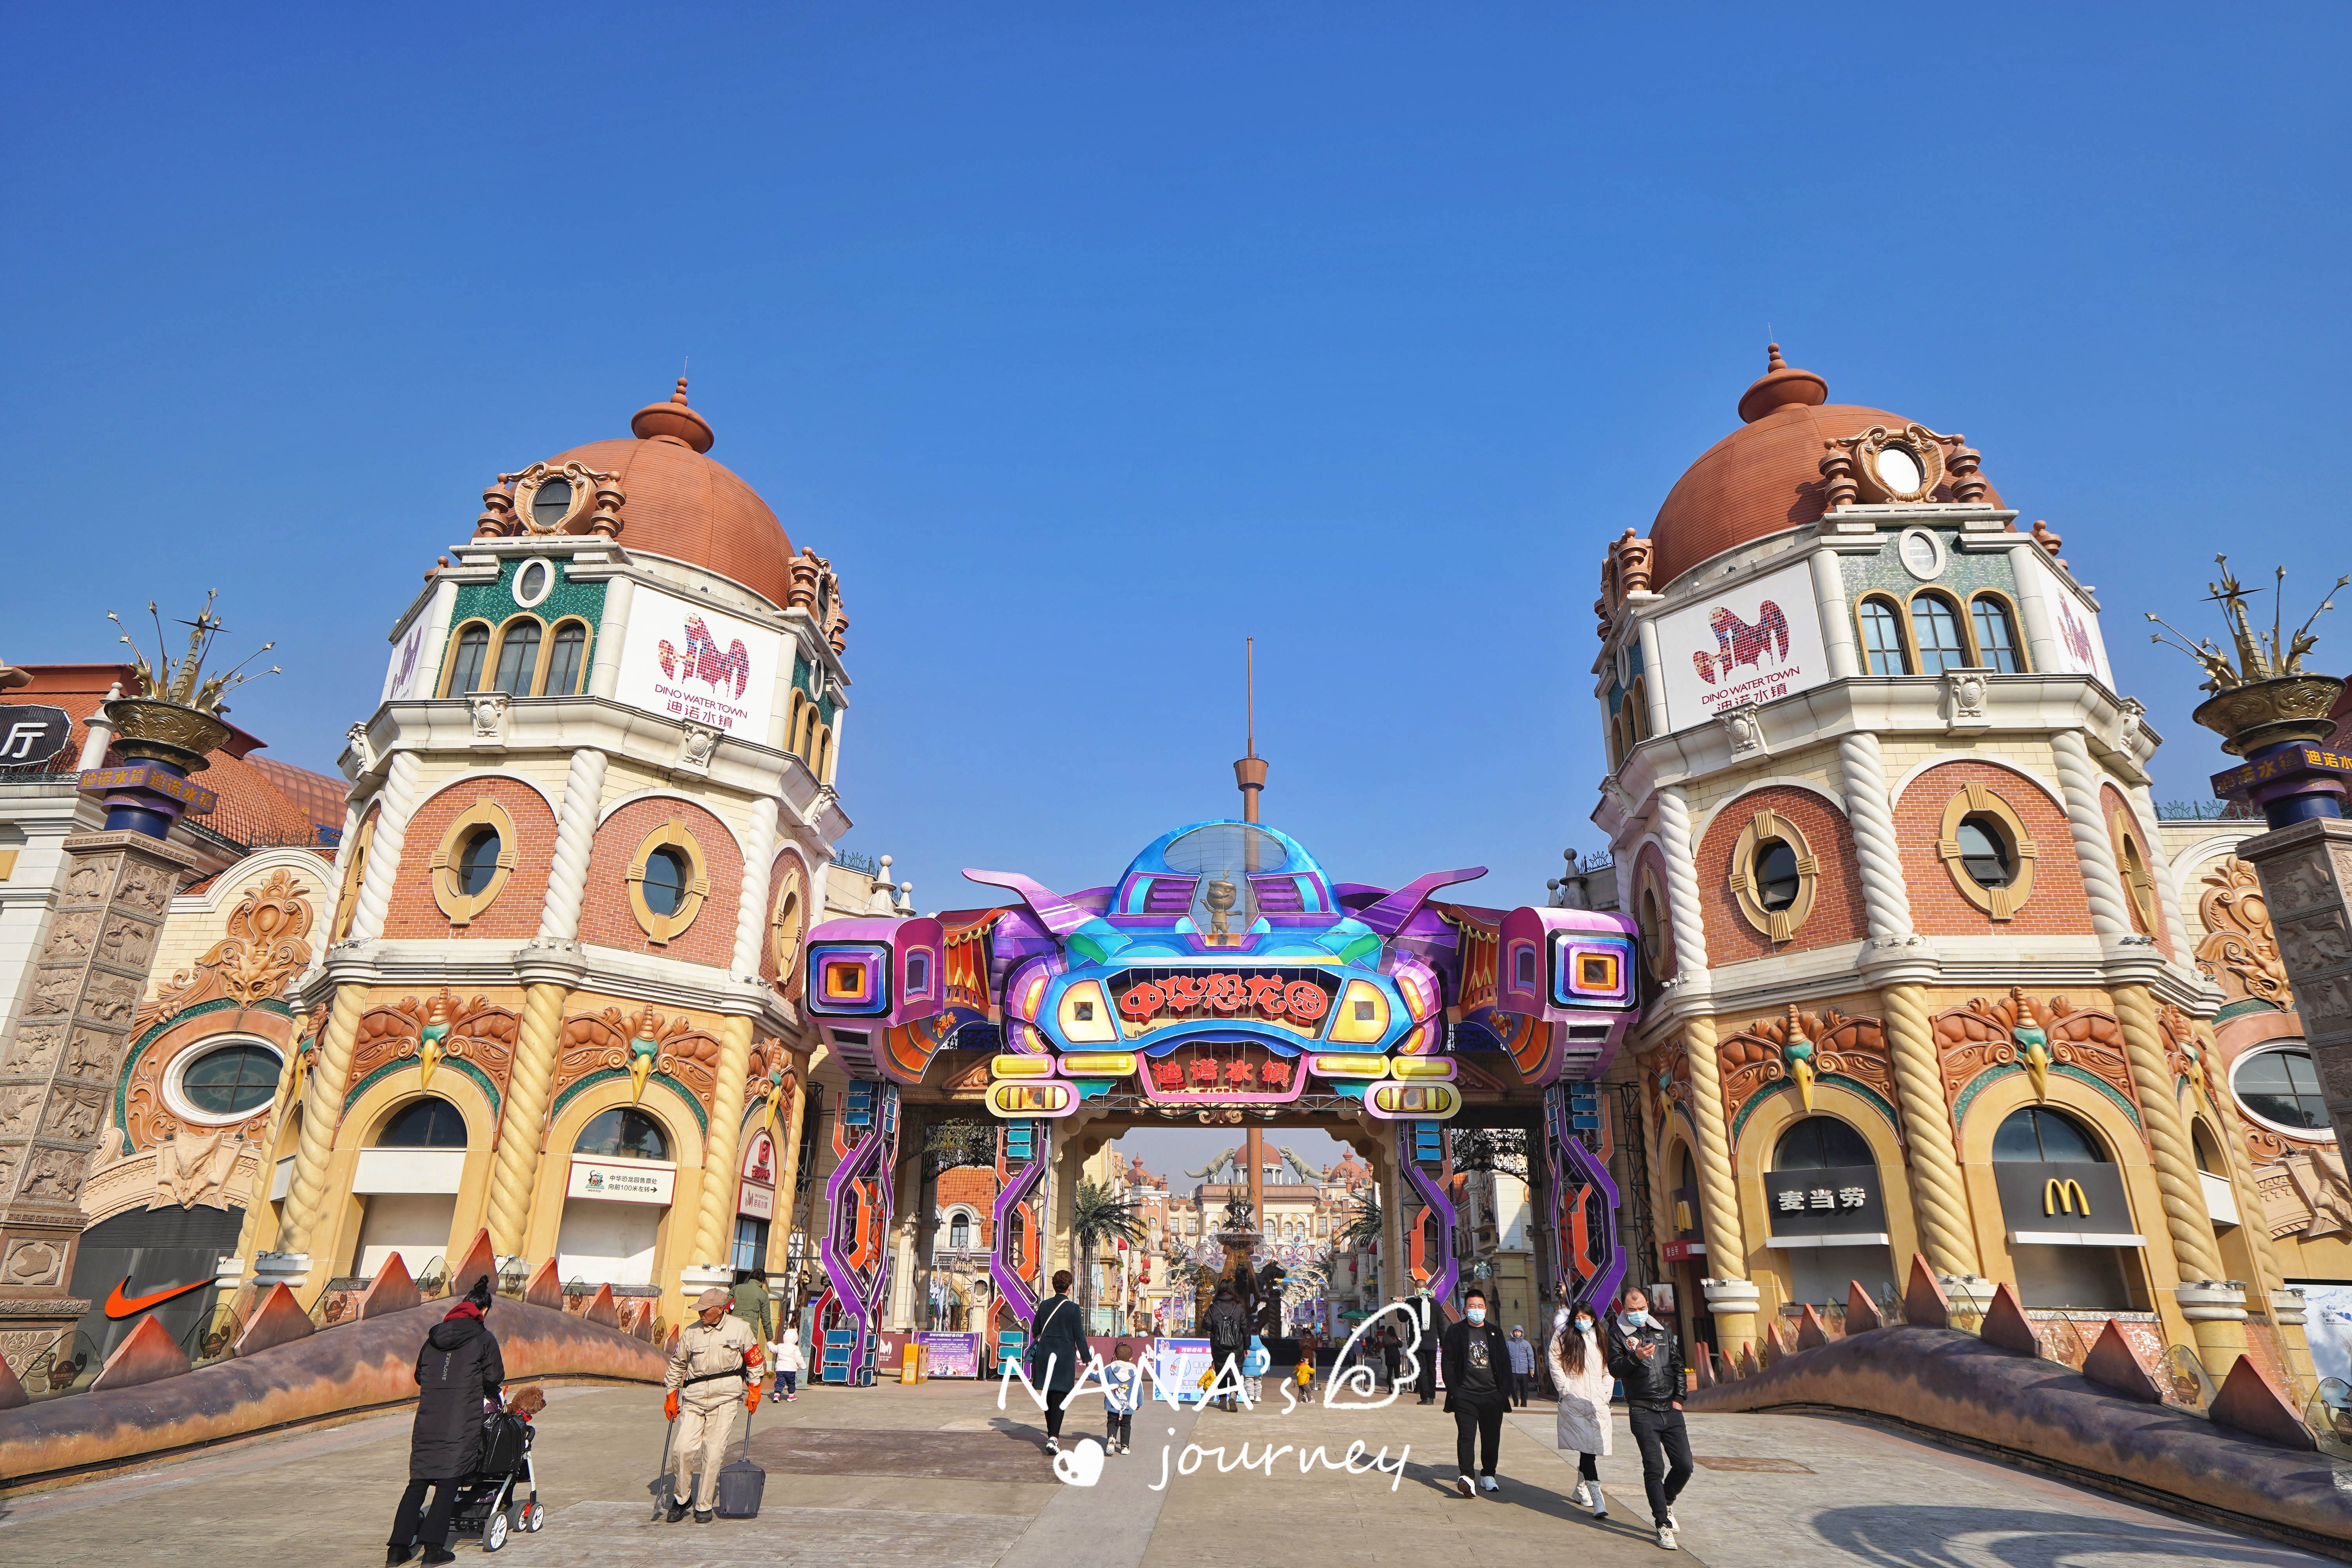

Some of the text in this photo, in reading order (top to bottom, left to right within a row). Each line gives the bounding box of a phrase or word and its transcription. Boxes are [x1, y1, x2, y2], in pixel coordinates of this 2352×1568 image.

[1702, 666, 1800, 704] DINO WATER TOWN
[655, 684, 748, 719] DINO WATER TOWN
[667, 699, 733, 729] 迪诺水镇
[0, 722, 48, 758] 厅
[80, 768, 145, 787] 迪诺水镇
[149, 770, 214, 809] 迪诺水镇
[1120, 973, 1328, 1020] 中华恐龙园
[1152, 1058, 1292, 1087] 迪诺水镇
[608, 1184, 650, 1192] 向前100米左转
[610, 1175, 657, 1185] 中华恐龙园售票处
[1778, 1187, 1866, 1211] 麦当劳
[442, 1352, 452, 1381] EXPLORE
